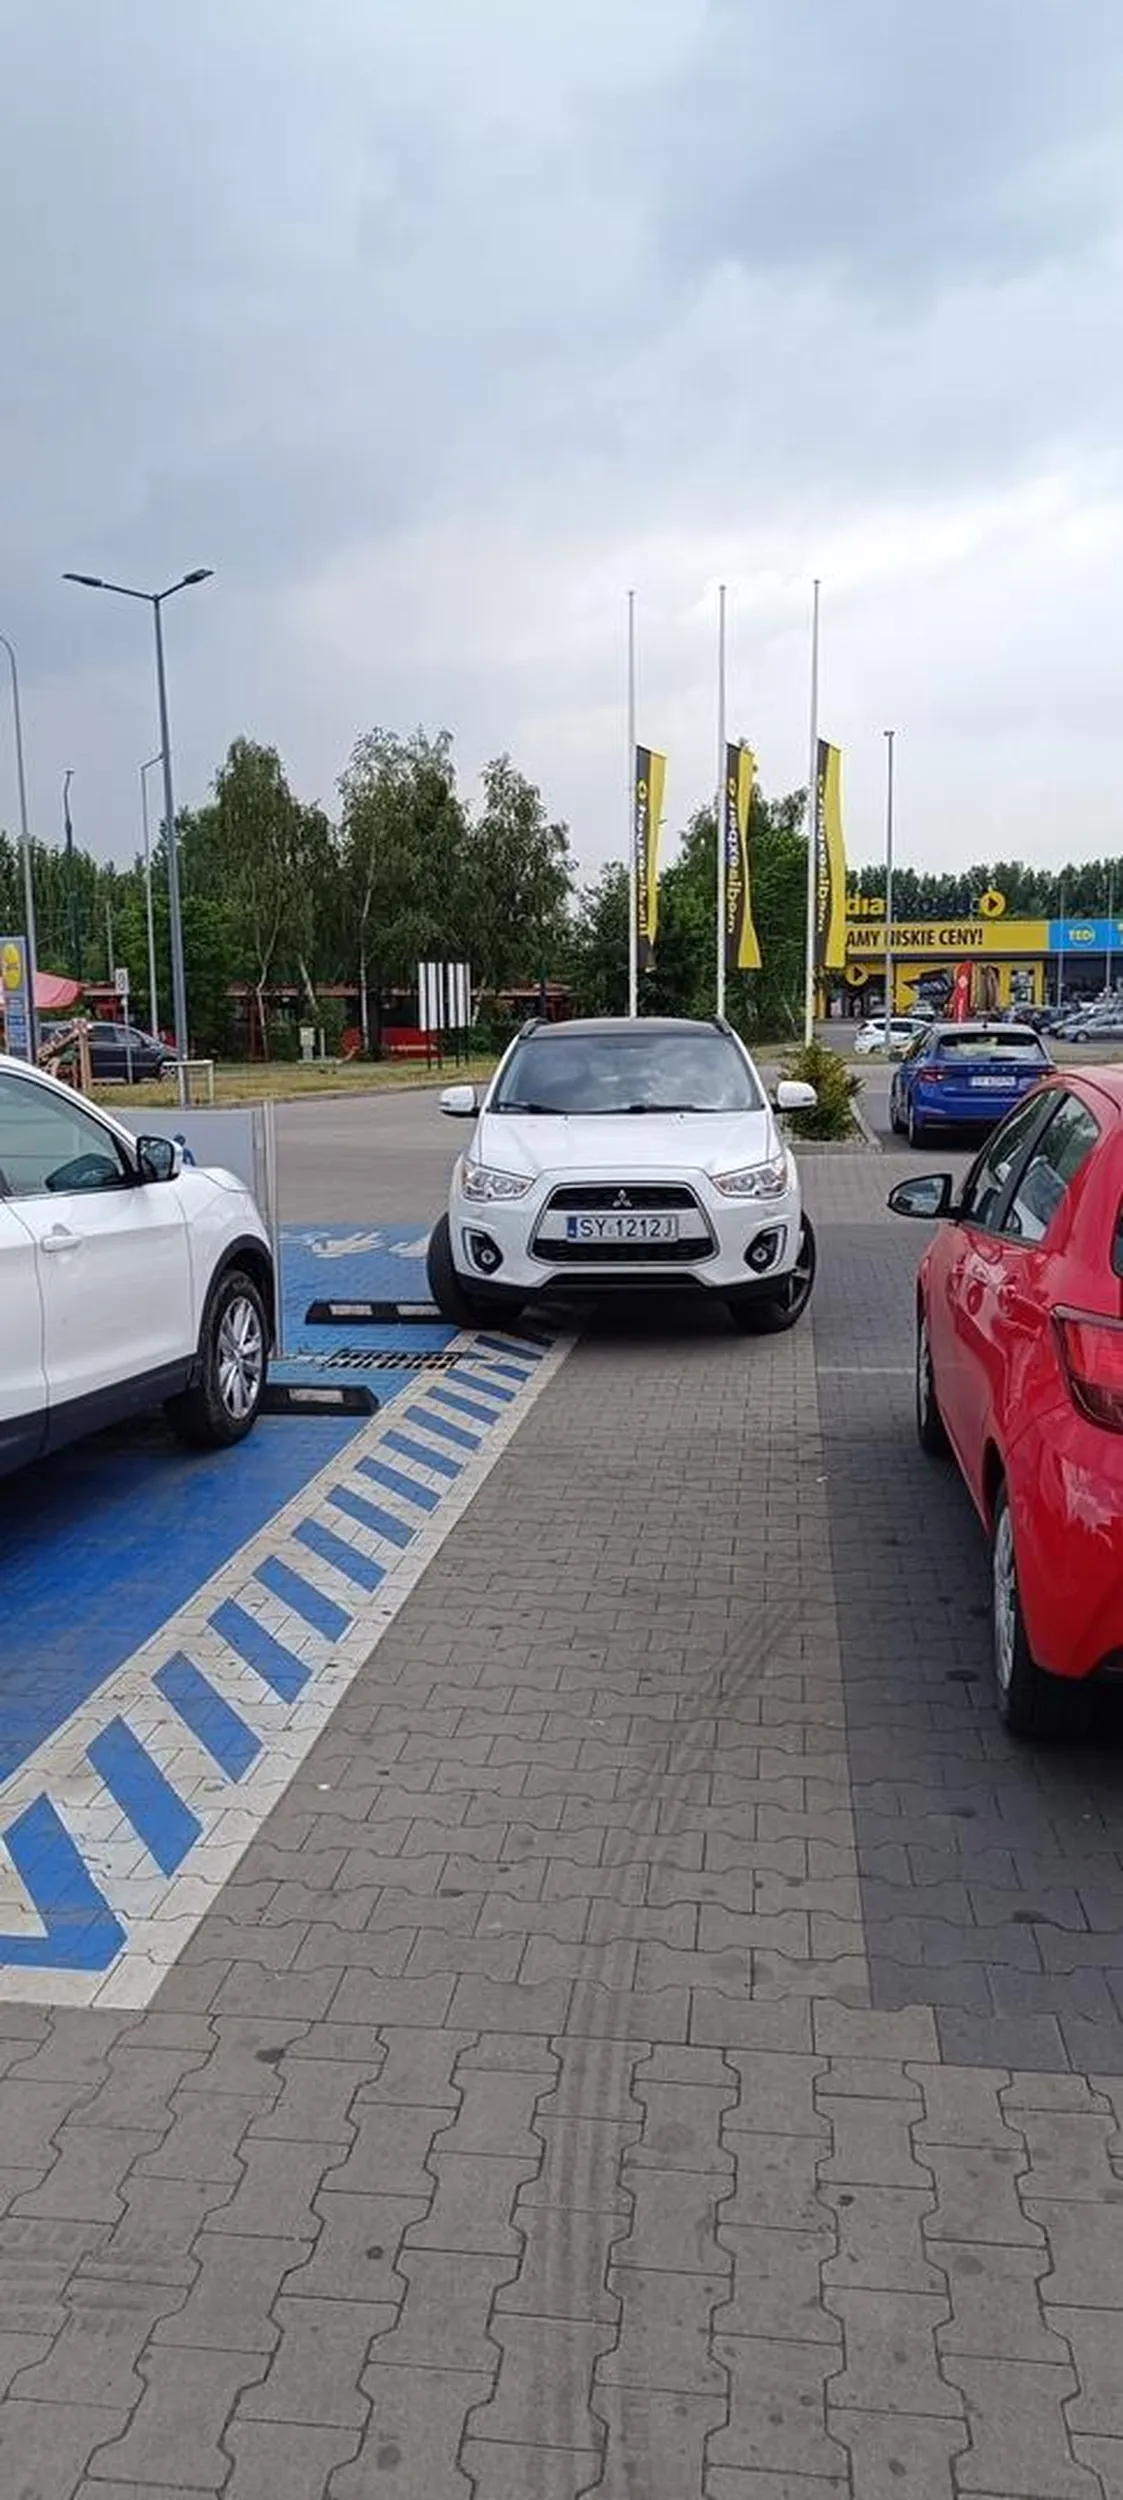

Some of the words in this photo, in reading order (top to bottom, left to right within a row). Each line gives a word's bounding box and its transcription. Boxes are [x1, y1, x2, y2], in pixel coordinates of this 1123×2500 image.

[846, 929, 880, 947] AMY
[939, 927, 983, 946] CENY!
[580, 1219, 606, 1237] SY
[616, 1219, 672, 1238] 1212J
